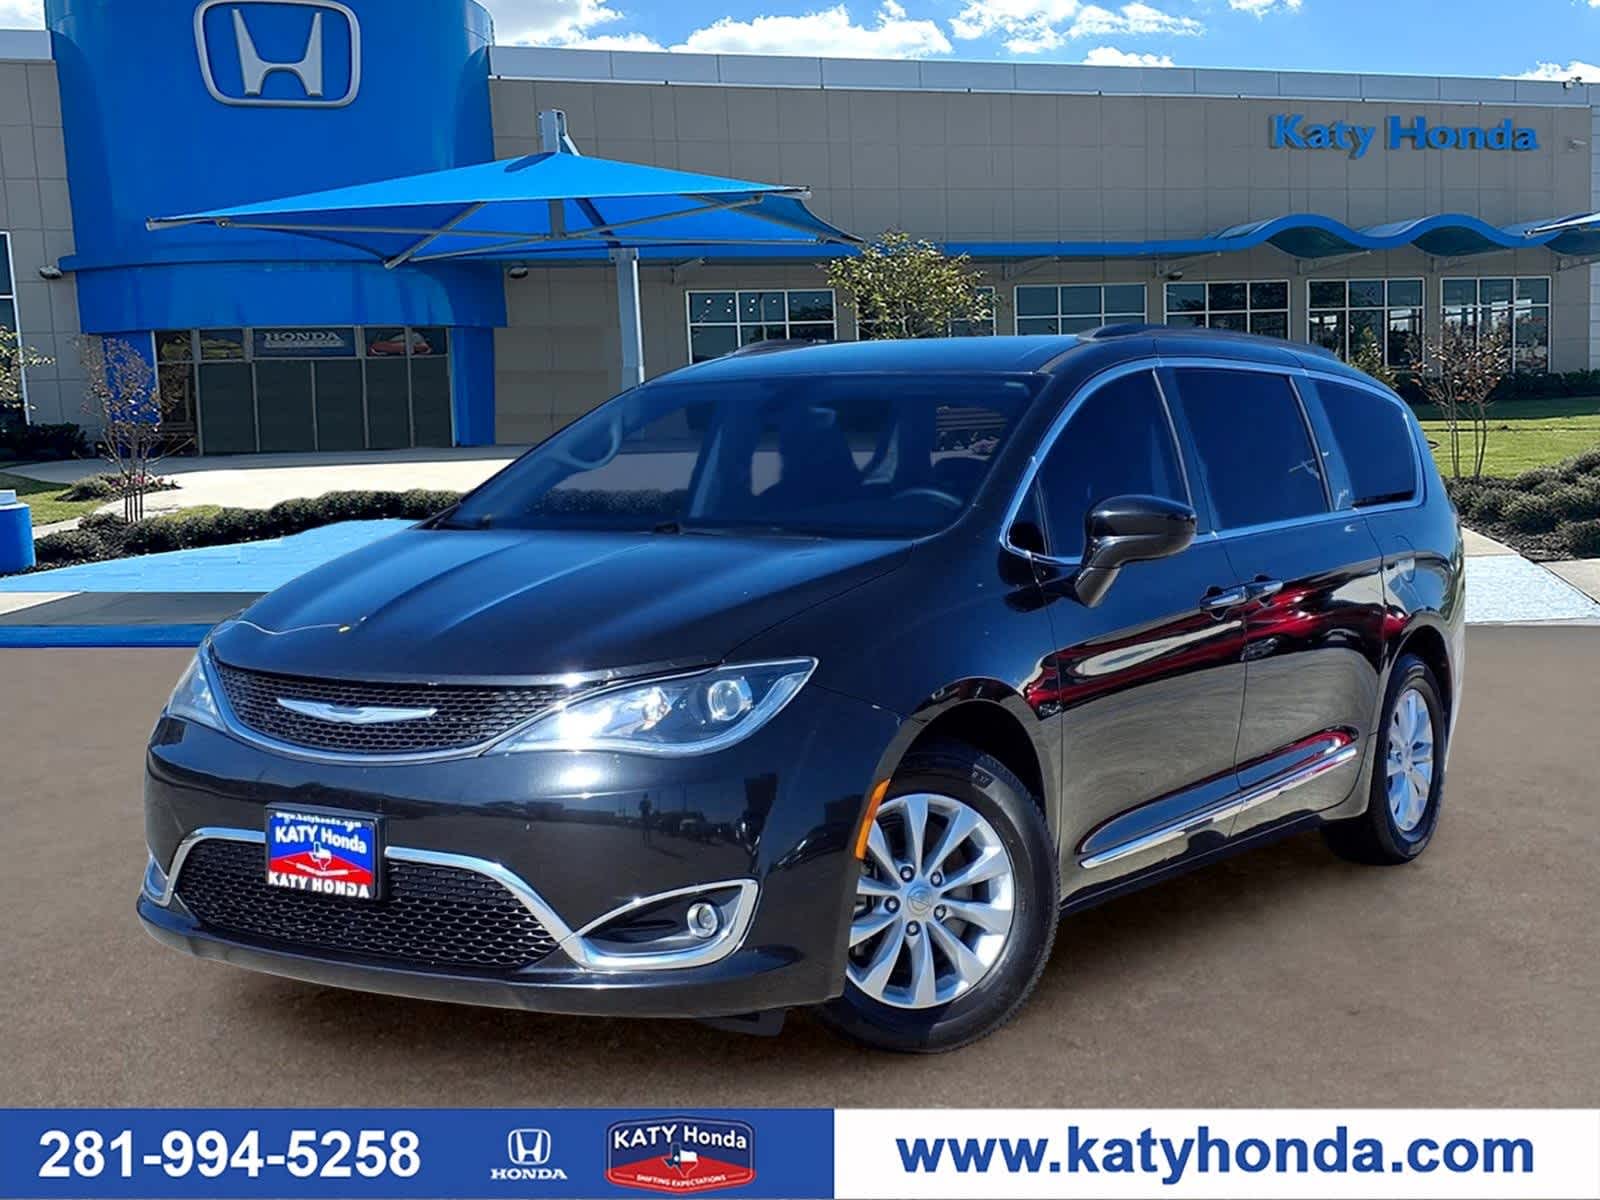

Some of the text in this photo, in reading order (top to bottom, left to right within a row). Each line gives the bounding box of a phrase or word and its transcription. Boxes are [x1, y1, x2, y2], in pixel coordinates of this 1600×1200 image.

[1270, 113, 1539, 159] Katy Honda
[264, 331, 342, 342] HONDA
[275, 825, 367, 854] KATY Honda
[268, 871, 370, 899] KATY HONDA
